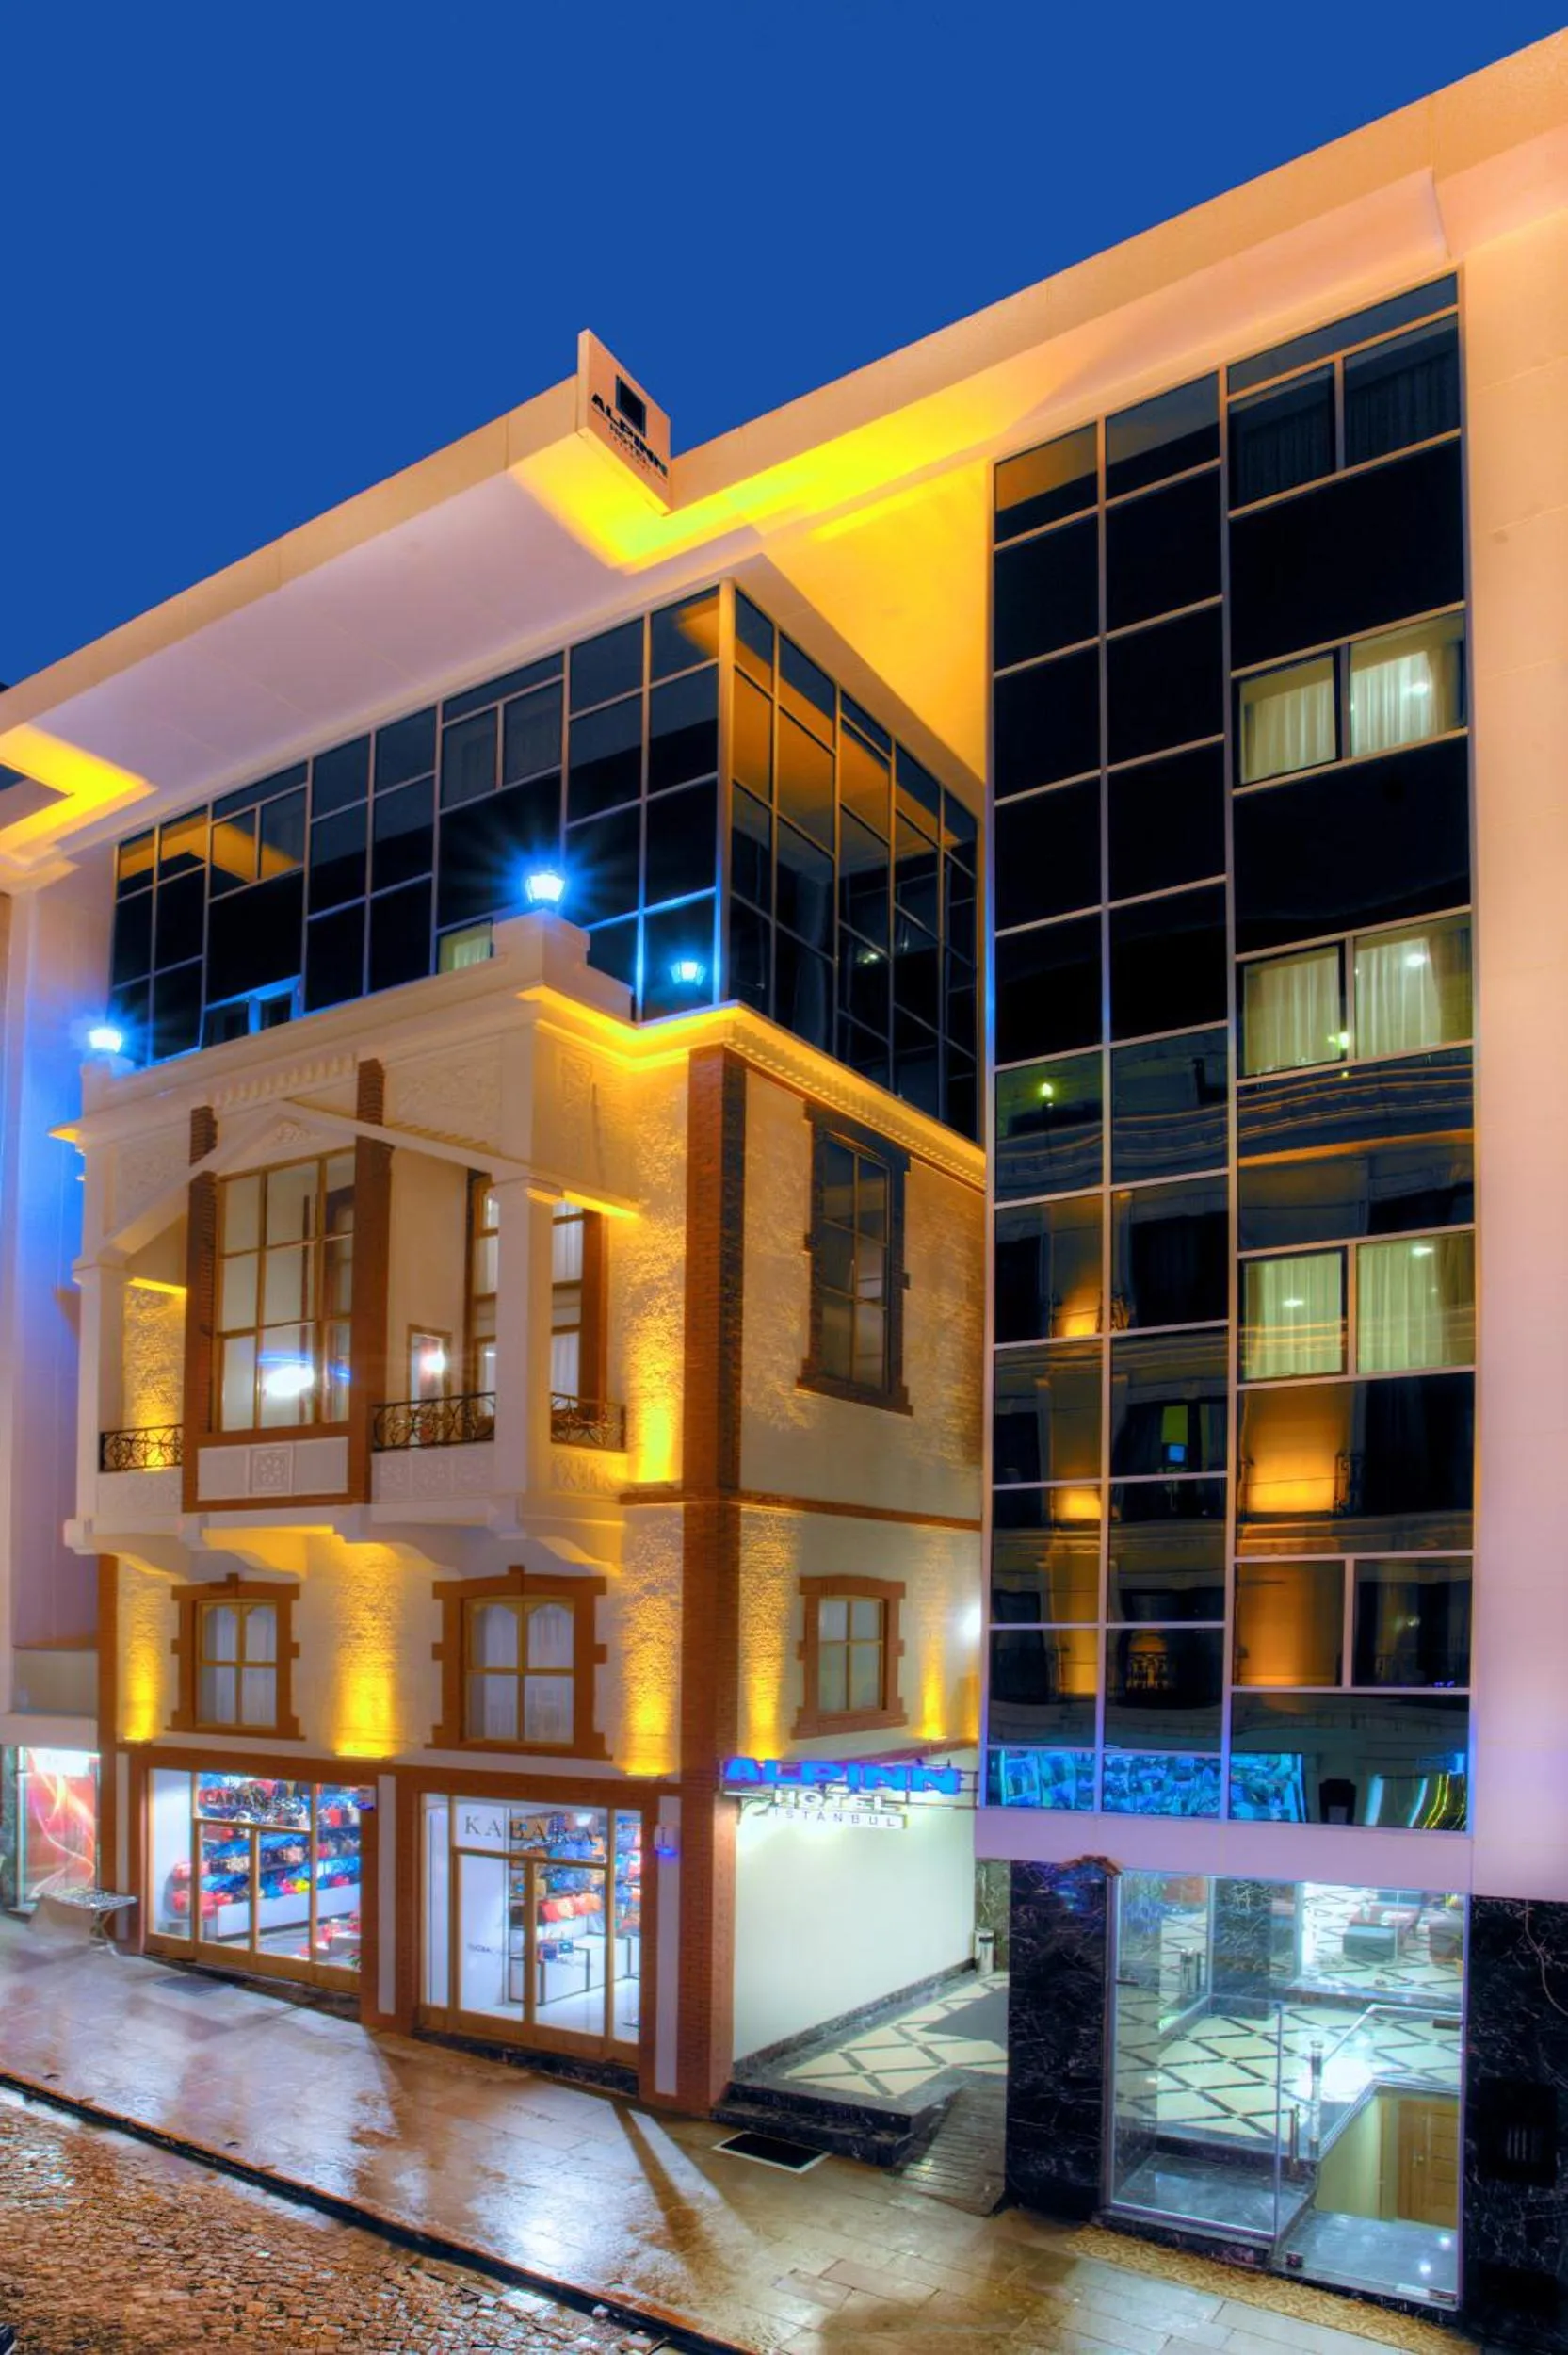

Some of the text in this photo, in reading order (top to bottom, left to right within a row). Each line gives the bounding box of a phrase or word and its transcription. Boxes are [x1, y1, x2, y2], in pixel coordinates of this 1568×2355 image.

[724, 1756, 961, 1795] ALPINN
[774, 1788, 899, 1811] HOTEL
[774, 1808, 896, 1827] ISTANBUL
